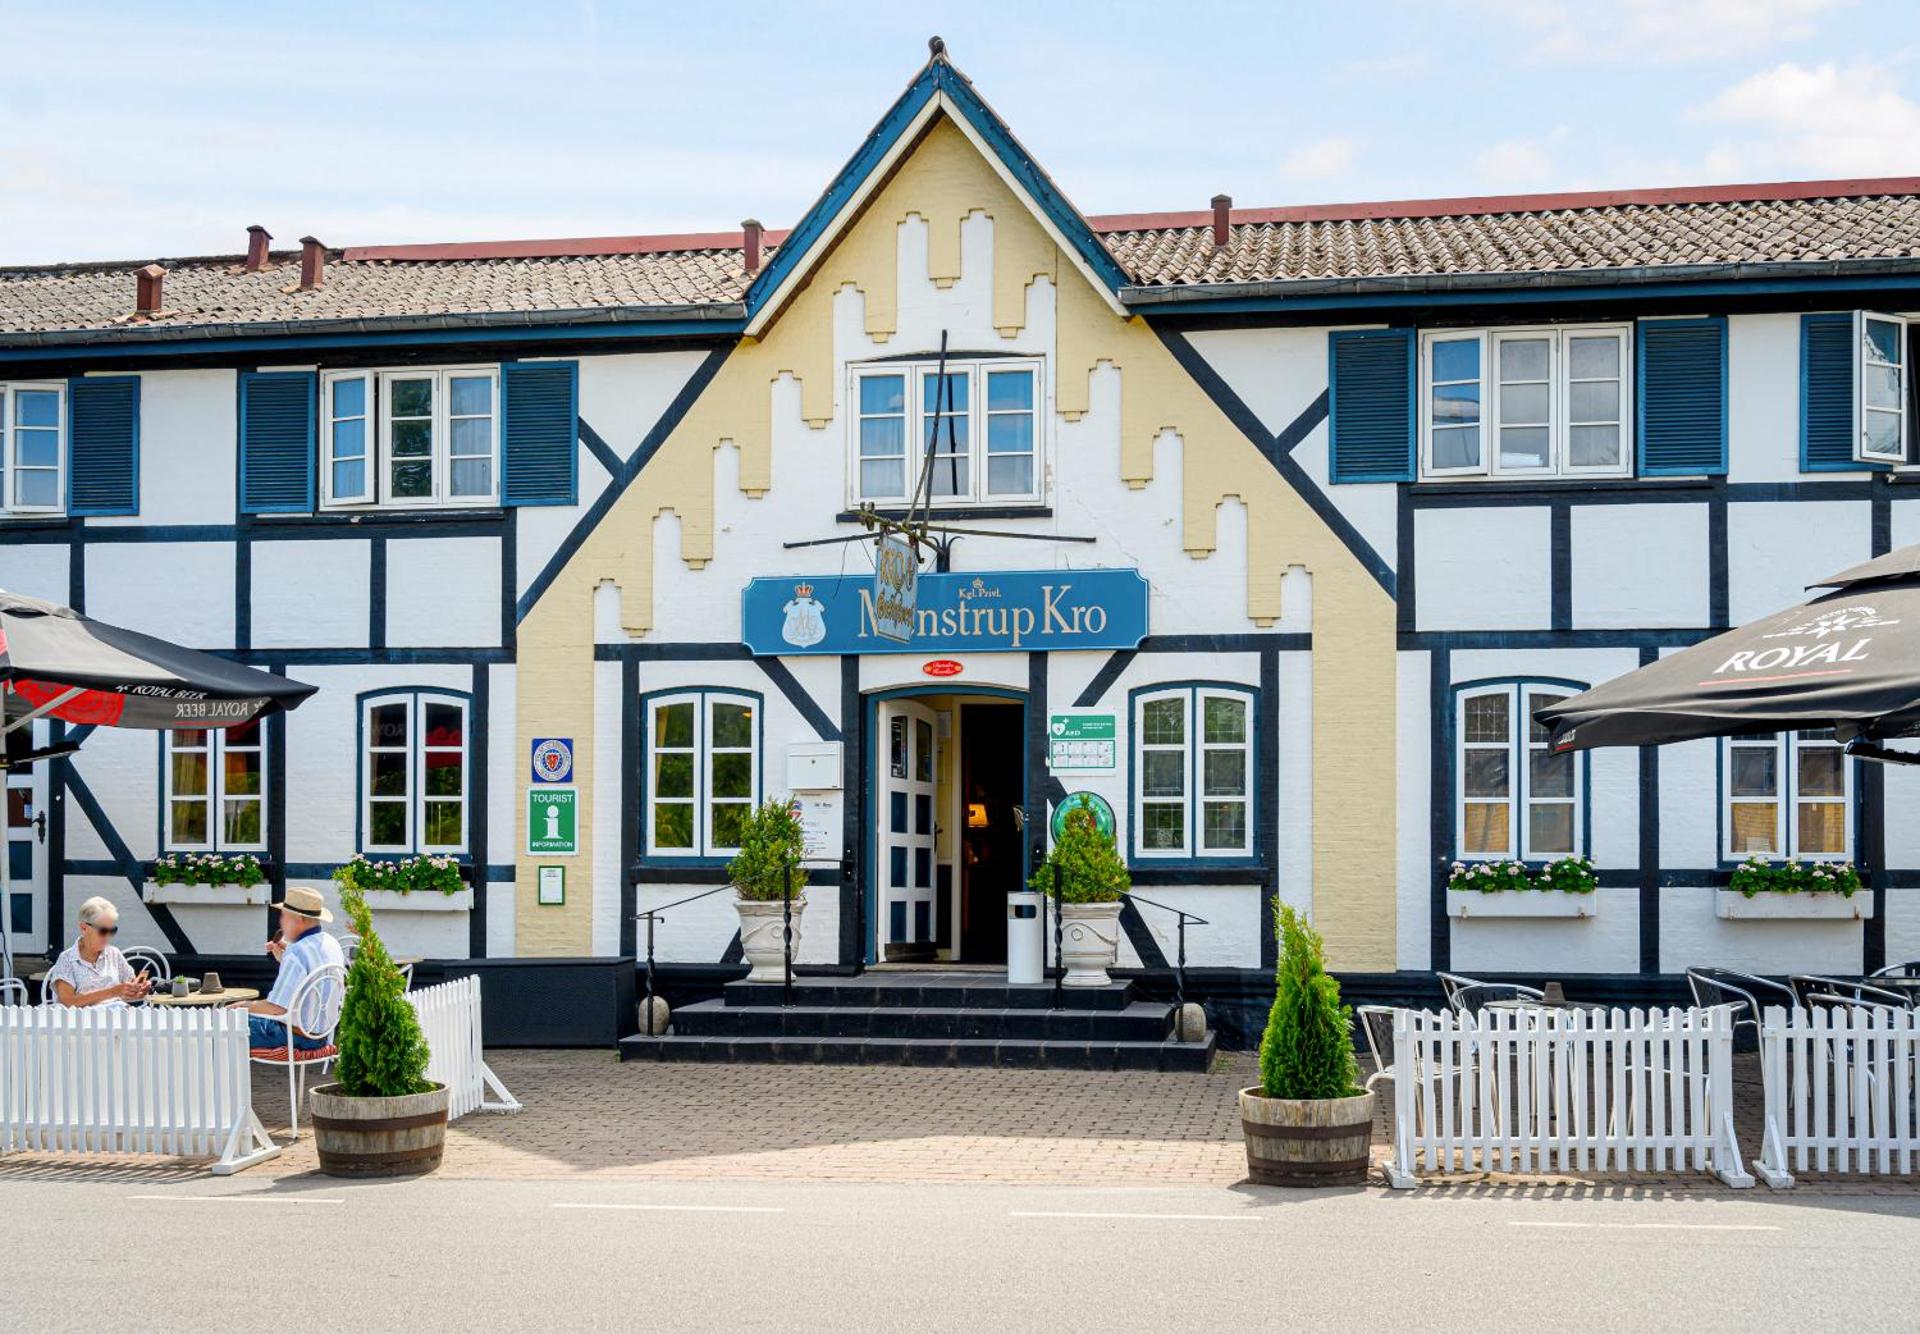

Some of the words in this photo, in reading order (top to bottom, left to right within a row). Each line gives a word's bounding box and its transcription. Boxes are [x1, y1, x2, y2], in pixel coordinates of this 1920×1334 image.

[857, 588, 1035, 648] Mnstrup
[1041, 584, 1107, 635] Kro
[1711, 637, 1873, 675] ROYAL
[132, 685, 176, 698] ROYAL
[532, 794, 573, 804] TOURIST
